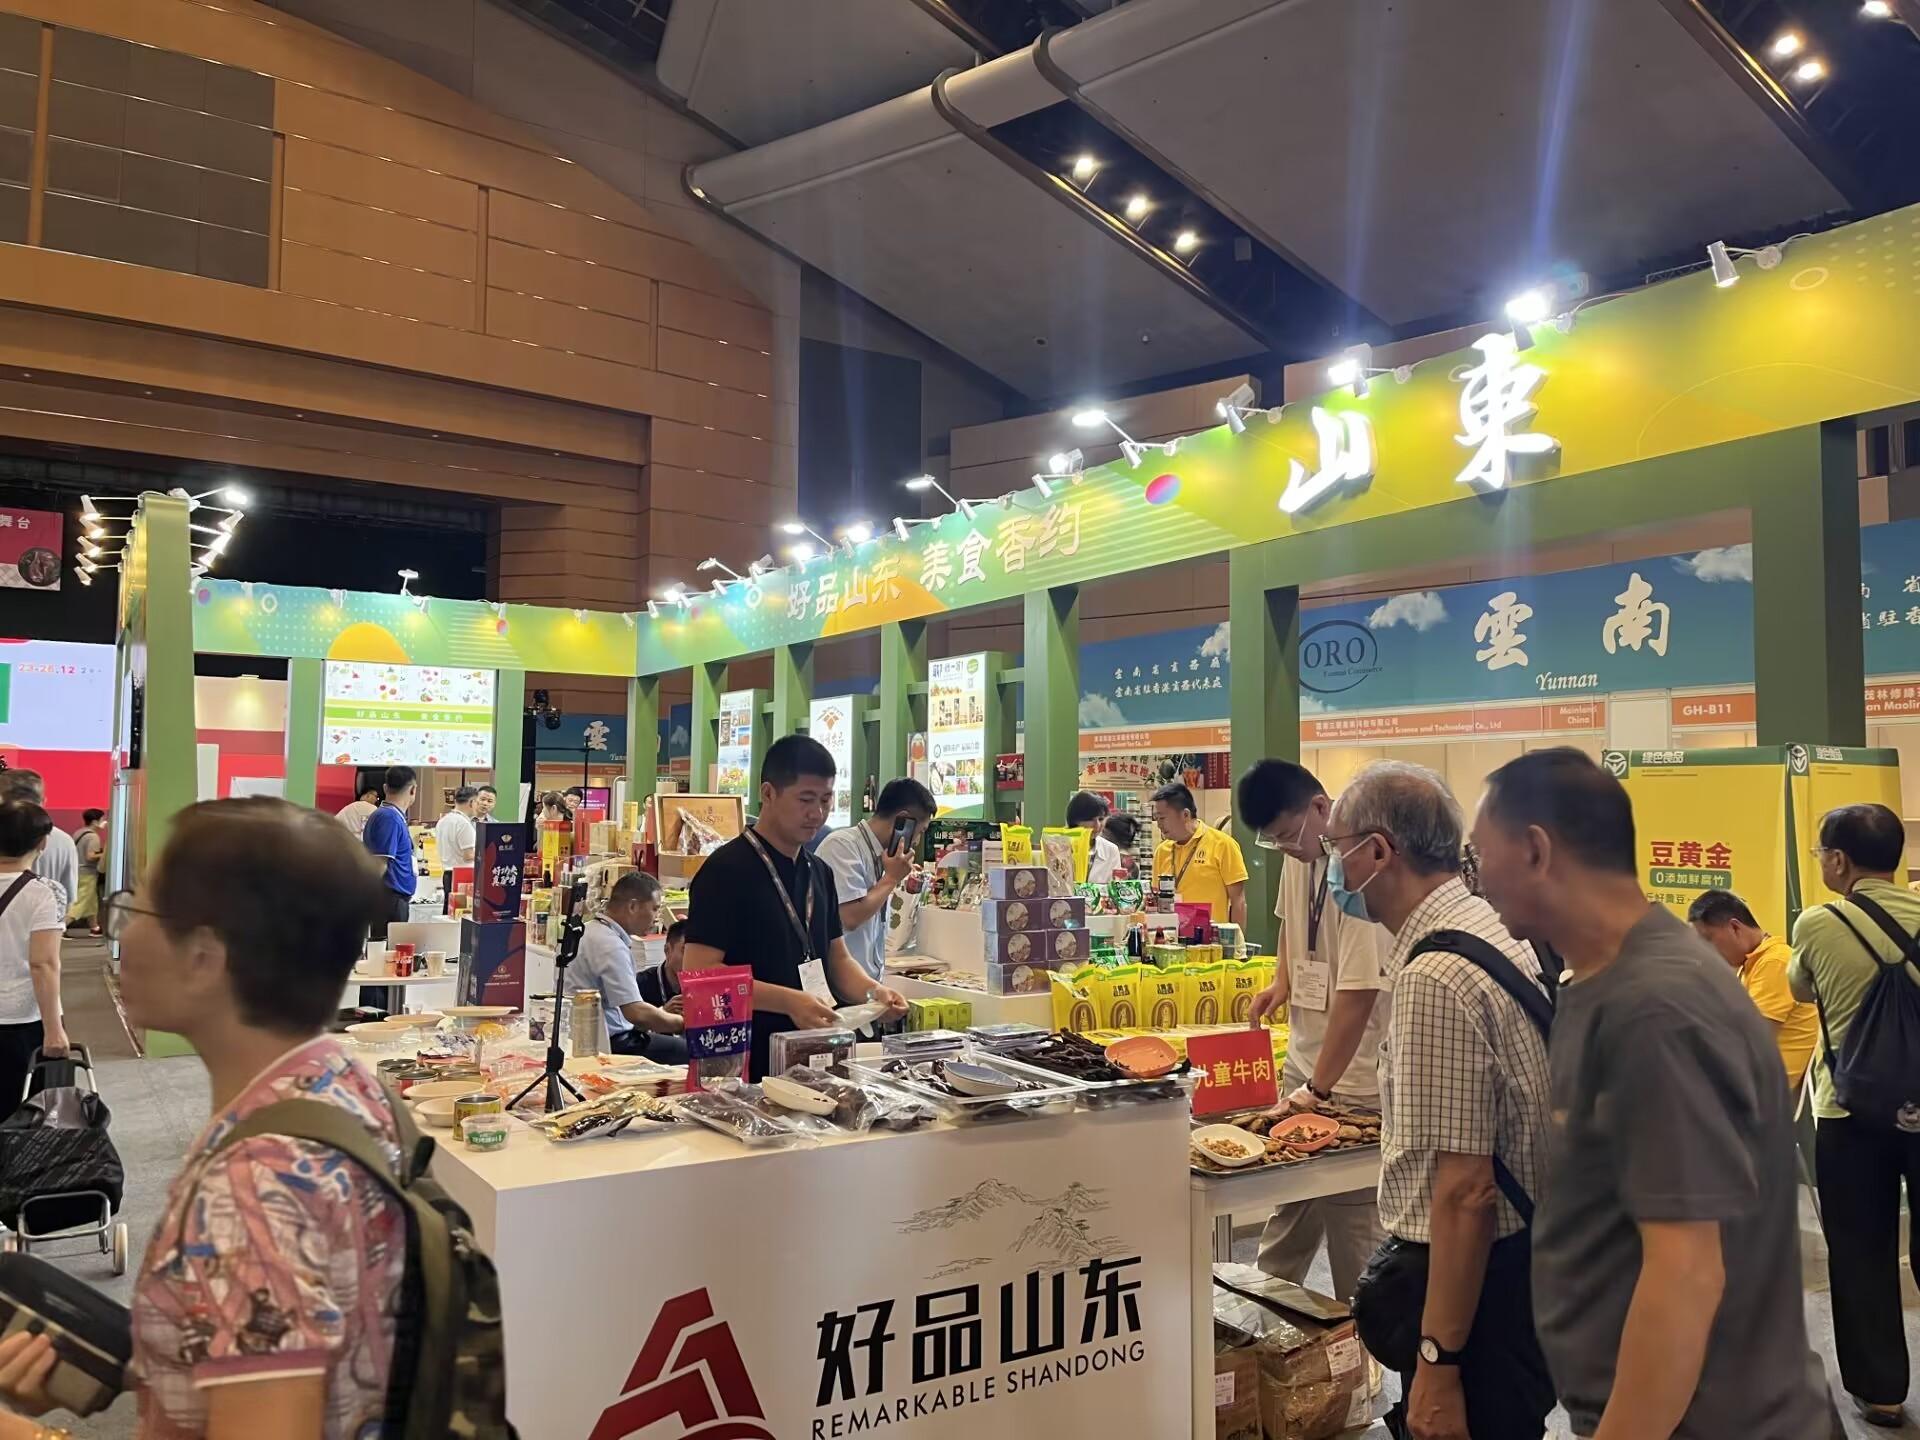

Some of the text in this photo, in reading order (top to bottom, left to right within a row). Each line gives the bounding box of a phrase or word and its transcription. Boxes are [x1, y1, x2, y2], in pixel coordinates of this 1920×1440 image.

[1278, 333, 1559, 513] 山東
[787, 502, 1083, 621] 好品山东 美食香约
[1303, 636, 1365, 669] ORO
[1473, 572, 1671, 671] 雲南
[1536, 672, 1599, 692] Yunnan
[1683, 703, 1732, 717] GH-B11
[1649, 841, 1732, 869] 豆黄金
[815, 1256, 1142, 1407] 好品山东
[811, 1375, 997, 1440] REMARKABLE
[1006, 1340, 1146, 1395] SHANDONG
